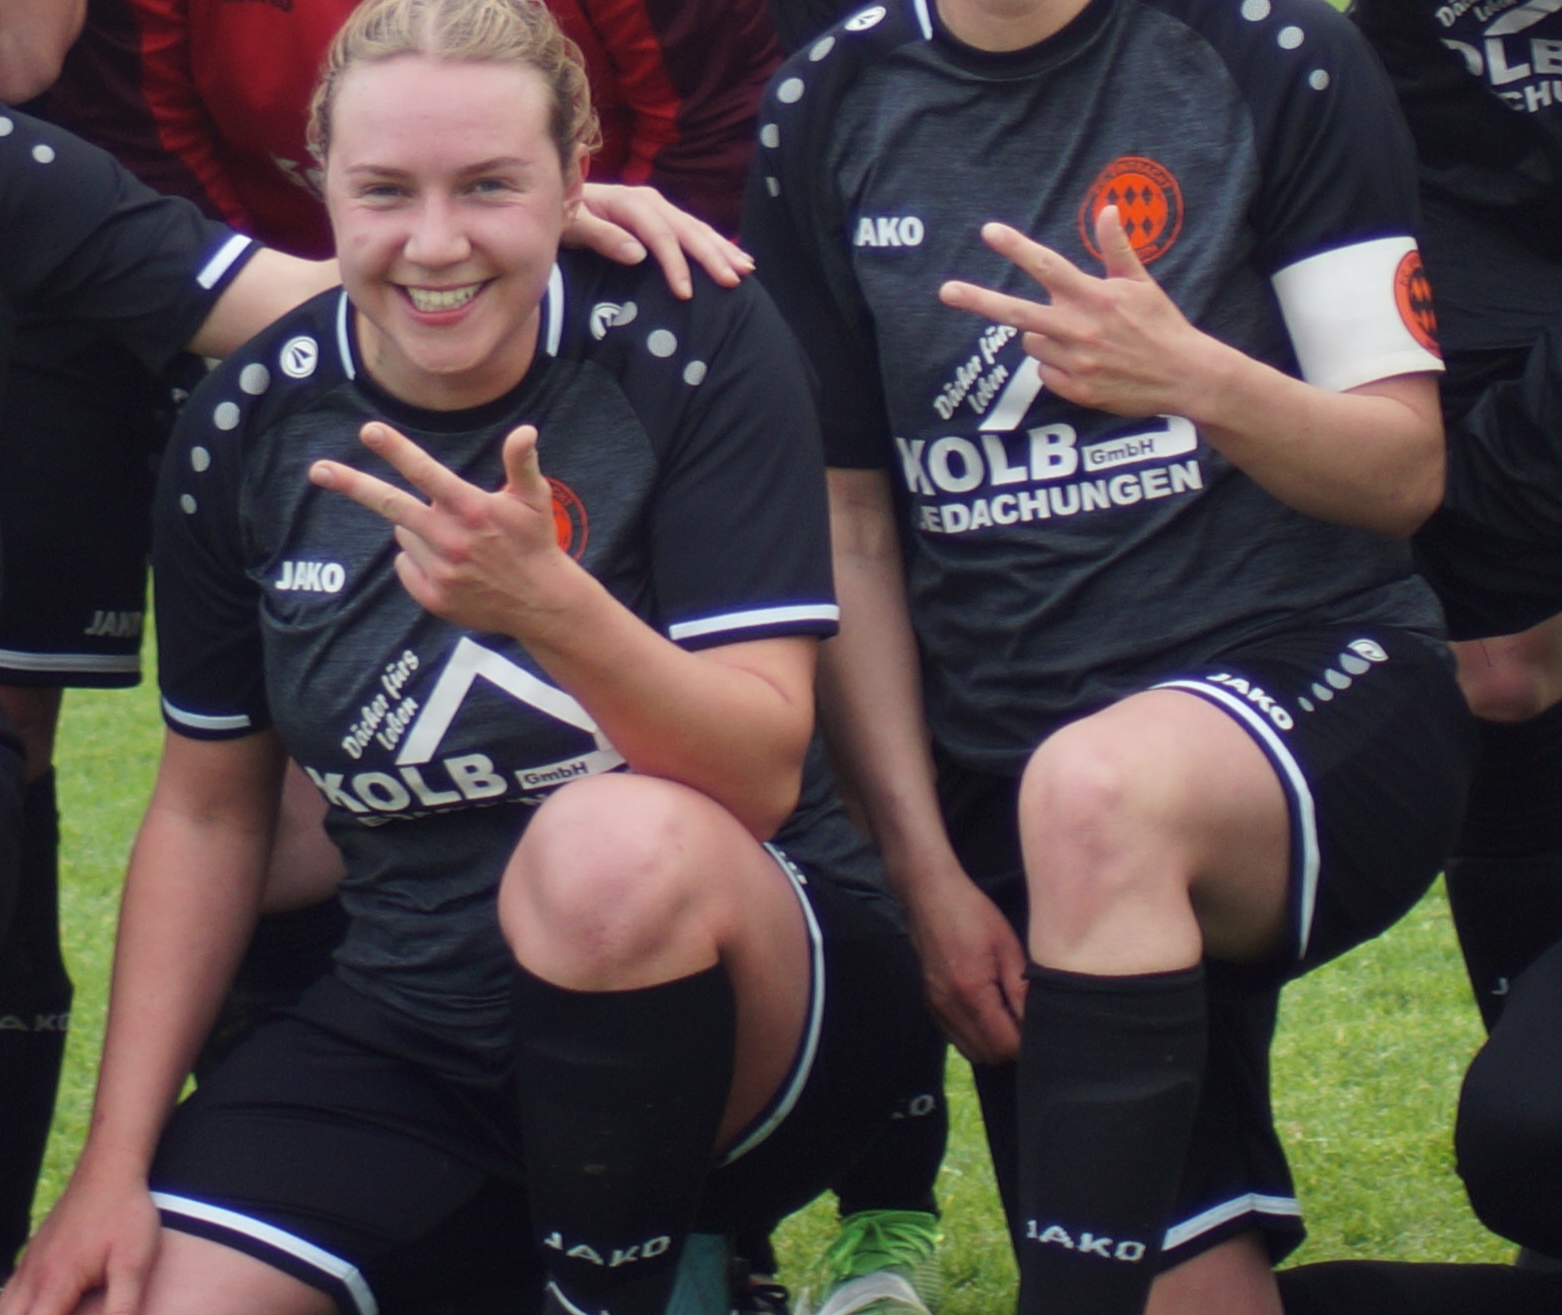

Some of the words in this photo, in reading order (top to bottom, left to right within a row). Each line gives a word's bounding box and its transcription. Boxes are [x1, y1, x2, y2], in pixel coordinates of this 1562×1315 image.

[854, 216, 925, 247] AKO
[896, 422, 1078, 496] KOLB
[1089, 437, 1156, 465] GmbH
[920, 459, 1204, 534] EDACHUNGEN
[275, 560, 346, 593] JAKO
[1206, 672, 1294, 730] JAKO
[304, 753, 509, 815] KOLB
[523, 761, 588, 786] GmbH
[543, 1231, 671, 1268] JAKO
[1026, 1219, 1146, 1262] JAKO
